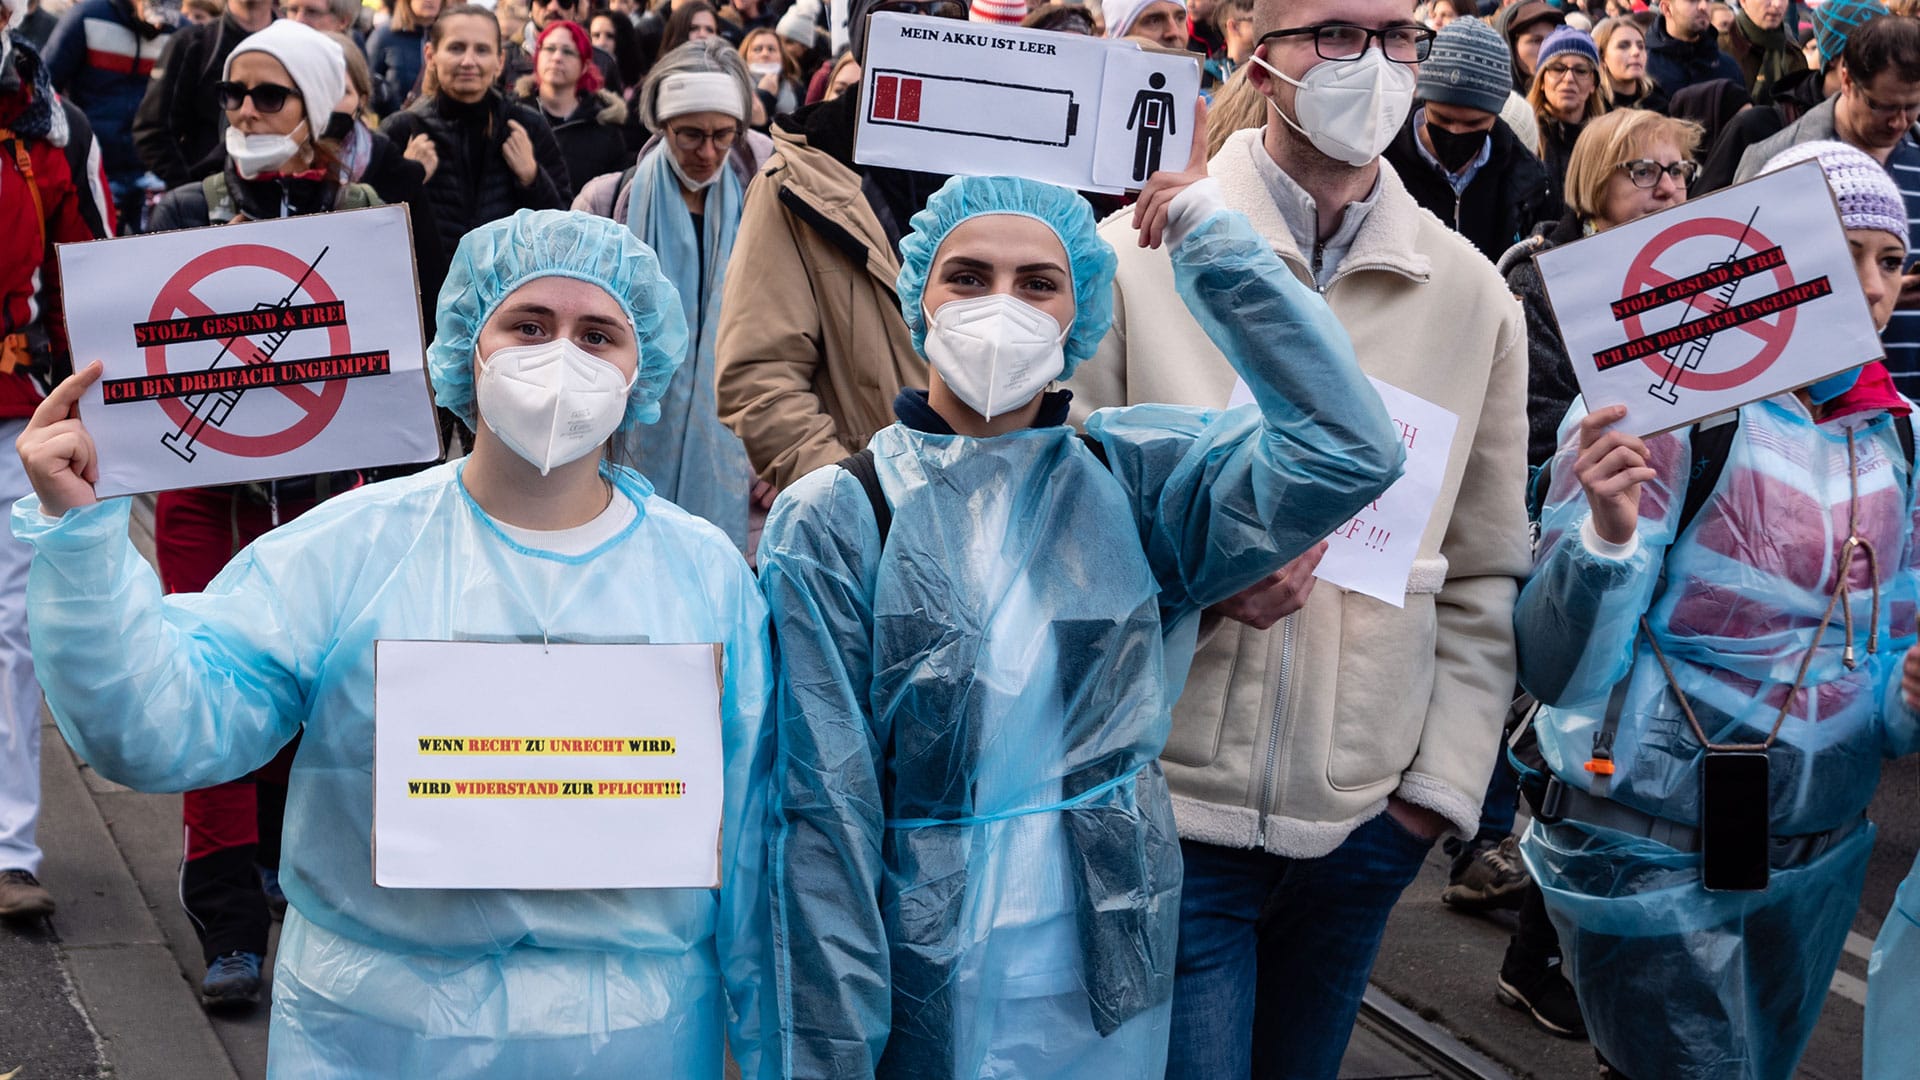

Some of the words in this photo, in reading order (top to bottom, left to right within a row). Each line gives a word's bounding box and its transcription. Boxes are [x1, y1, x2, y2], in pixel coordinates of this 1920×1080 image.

[900, 26, 939, 41] MEIN
[942, 32, 988, 47] AKKU
[991, 37, 1016, 50] IST
[1019, 41, 1057, 56] LEER
[1613, 294, 1664, 319] STOLZ,
[1667, 269, 1729, 298] GESUND
[1732, 262, 1745, 278] &
[1748, 248, 1785, 272] FREI
[135, 322, 198, 343] STOLZ,
[202, 311, 278, 335] GESUND
[282, 310, 297, 326] &
[300, 304, 346, 323] FREI
[1594, 350, 1624, 368] ICH
[1628, 340, 1656, 359] BIN
[1657, 314, 1737, 345] DREIFACH
[1740, 279, 1829, 320] UNGEIMPFT
[103, 380, 137, 401] ICH
[142, 377, 176, 398] BIN
[181, 363, 275, 392] DREIFACH
[281, 354, 389, 381] UNGEIMPFT
[1392, 418, 1419, 449] H
[419, 738, 464, 752] WENN
[469, 739, 522, 752] RECHT
[526, 740, 545, 752] ZU
[550, 740, 625, 753] UNRECHT
[629, 740, 676, 754] WIRD,
[408, 782, 451, 795] WIRD
[455, 782, 559, 795] WIDERSTAND
[562, 783, 594, 795] ZUR
[598, 782, 687, 795] PFLICHT!!!!
